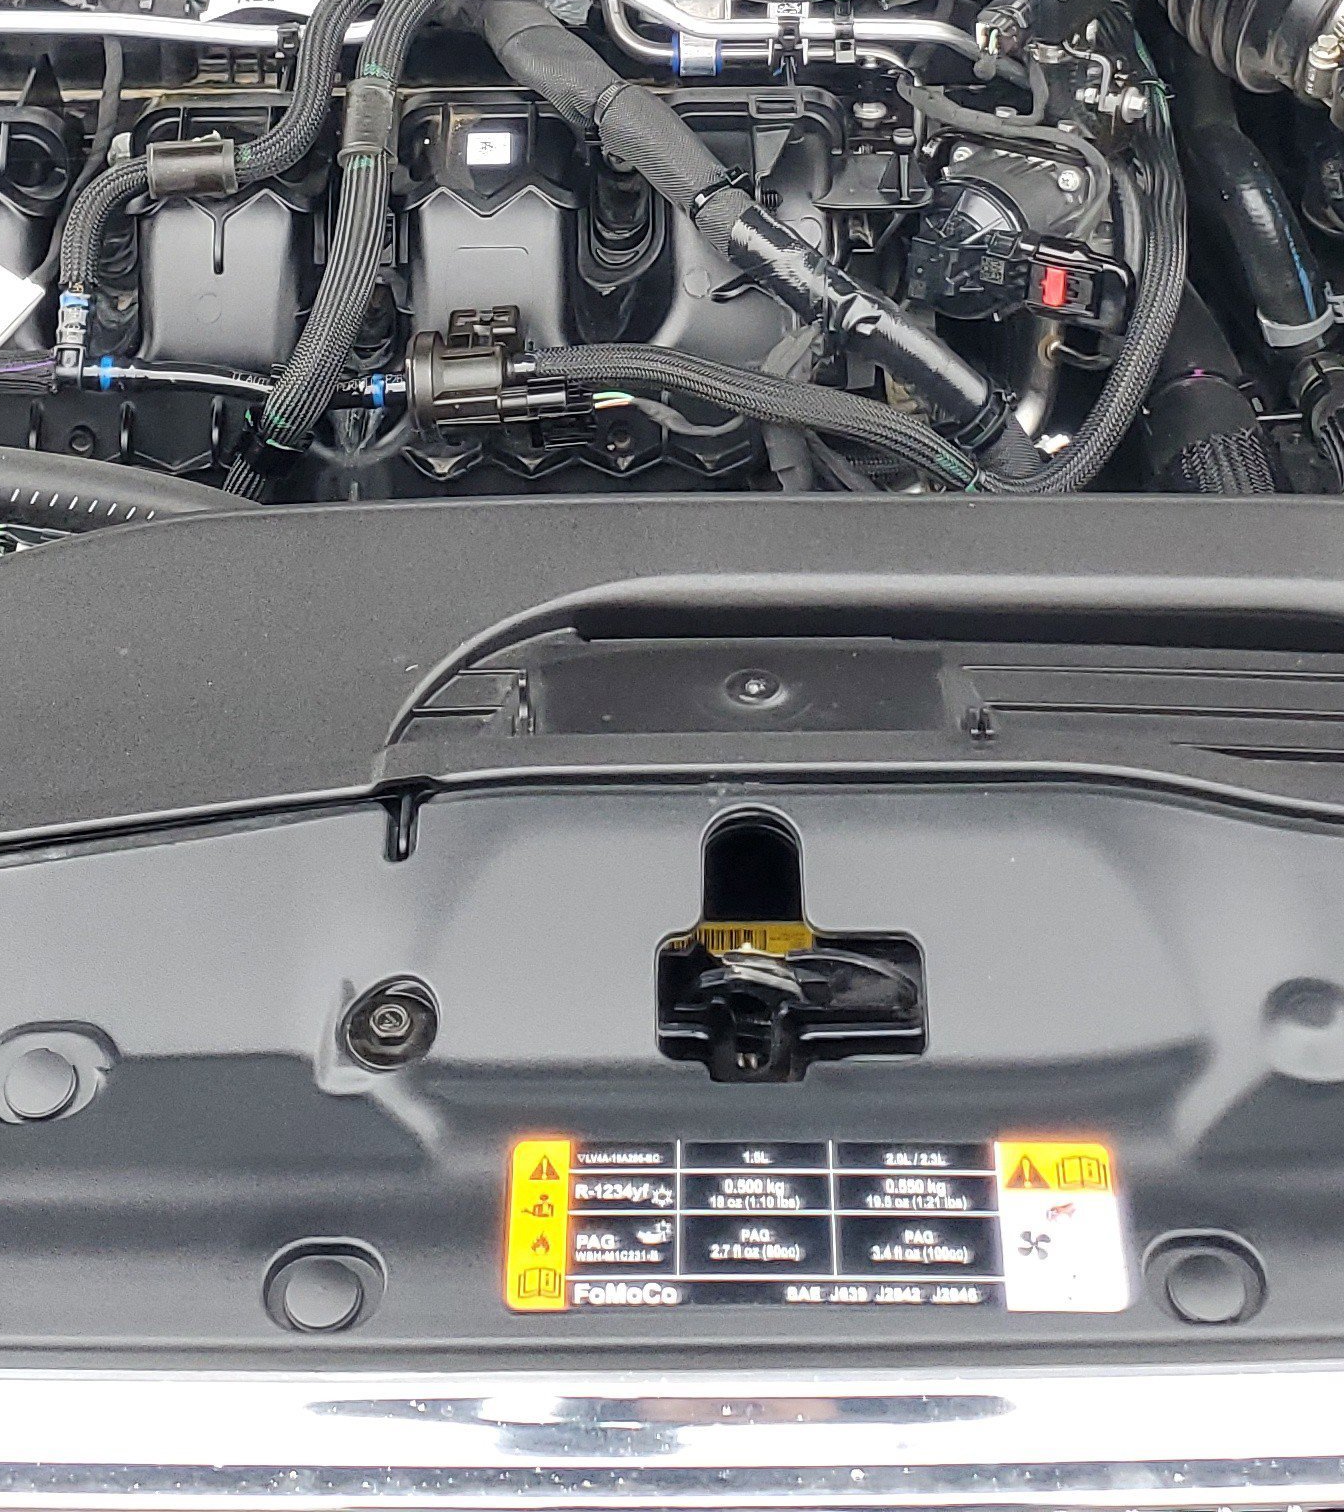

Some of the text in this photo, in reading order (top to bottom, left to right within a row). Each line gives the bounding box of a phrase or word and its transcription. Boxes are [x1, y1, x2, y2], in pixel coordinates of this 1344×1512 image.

[575, 1183, 650, 1202] R-1234yf
[724, 1178, 784, 1196] 0.500 kg
[885, 1178, 946, 1197] 0.550 kg
[727, 1198, 743, 1208] oz
[777, 1195, 800, 1210] lbs)
[895, 1198, 910, 1208] oz
[944, 1194, 967, 1210] lbs)
[576, 1234, 616, 1250] PAG
[741, 1228, 770, 1242] PAG
[904, 1229, 935, 1244] PAG
[710, 1244, 730, 1259] 2.7
[744, 1247, 759, 1259] oz
[871, 1245, 891, 1261] 3.4
[905, 1248, 921, 1261] oz
[574, 1282, 678, 1305] FoMoCo
[787, 1286, 821, 1302] SAE
